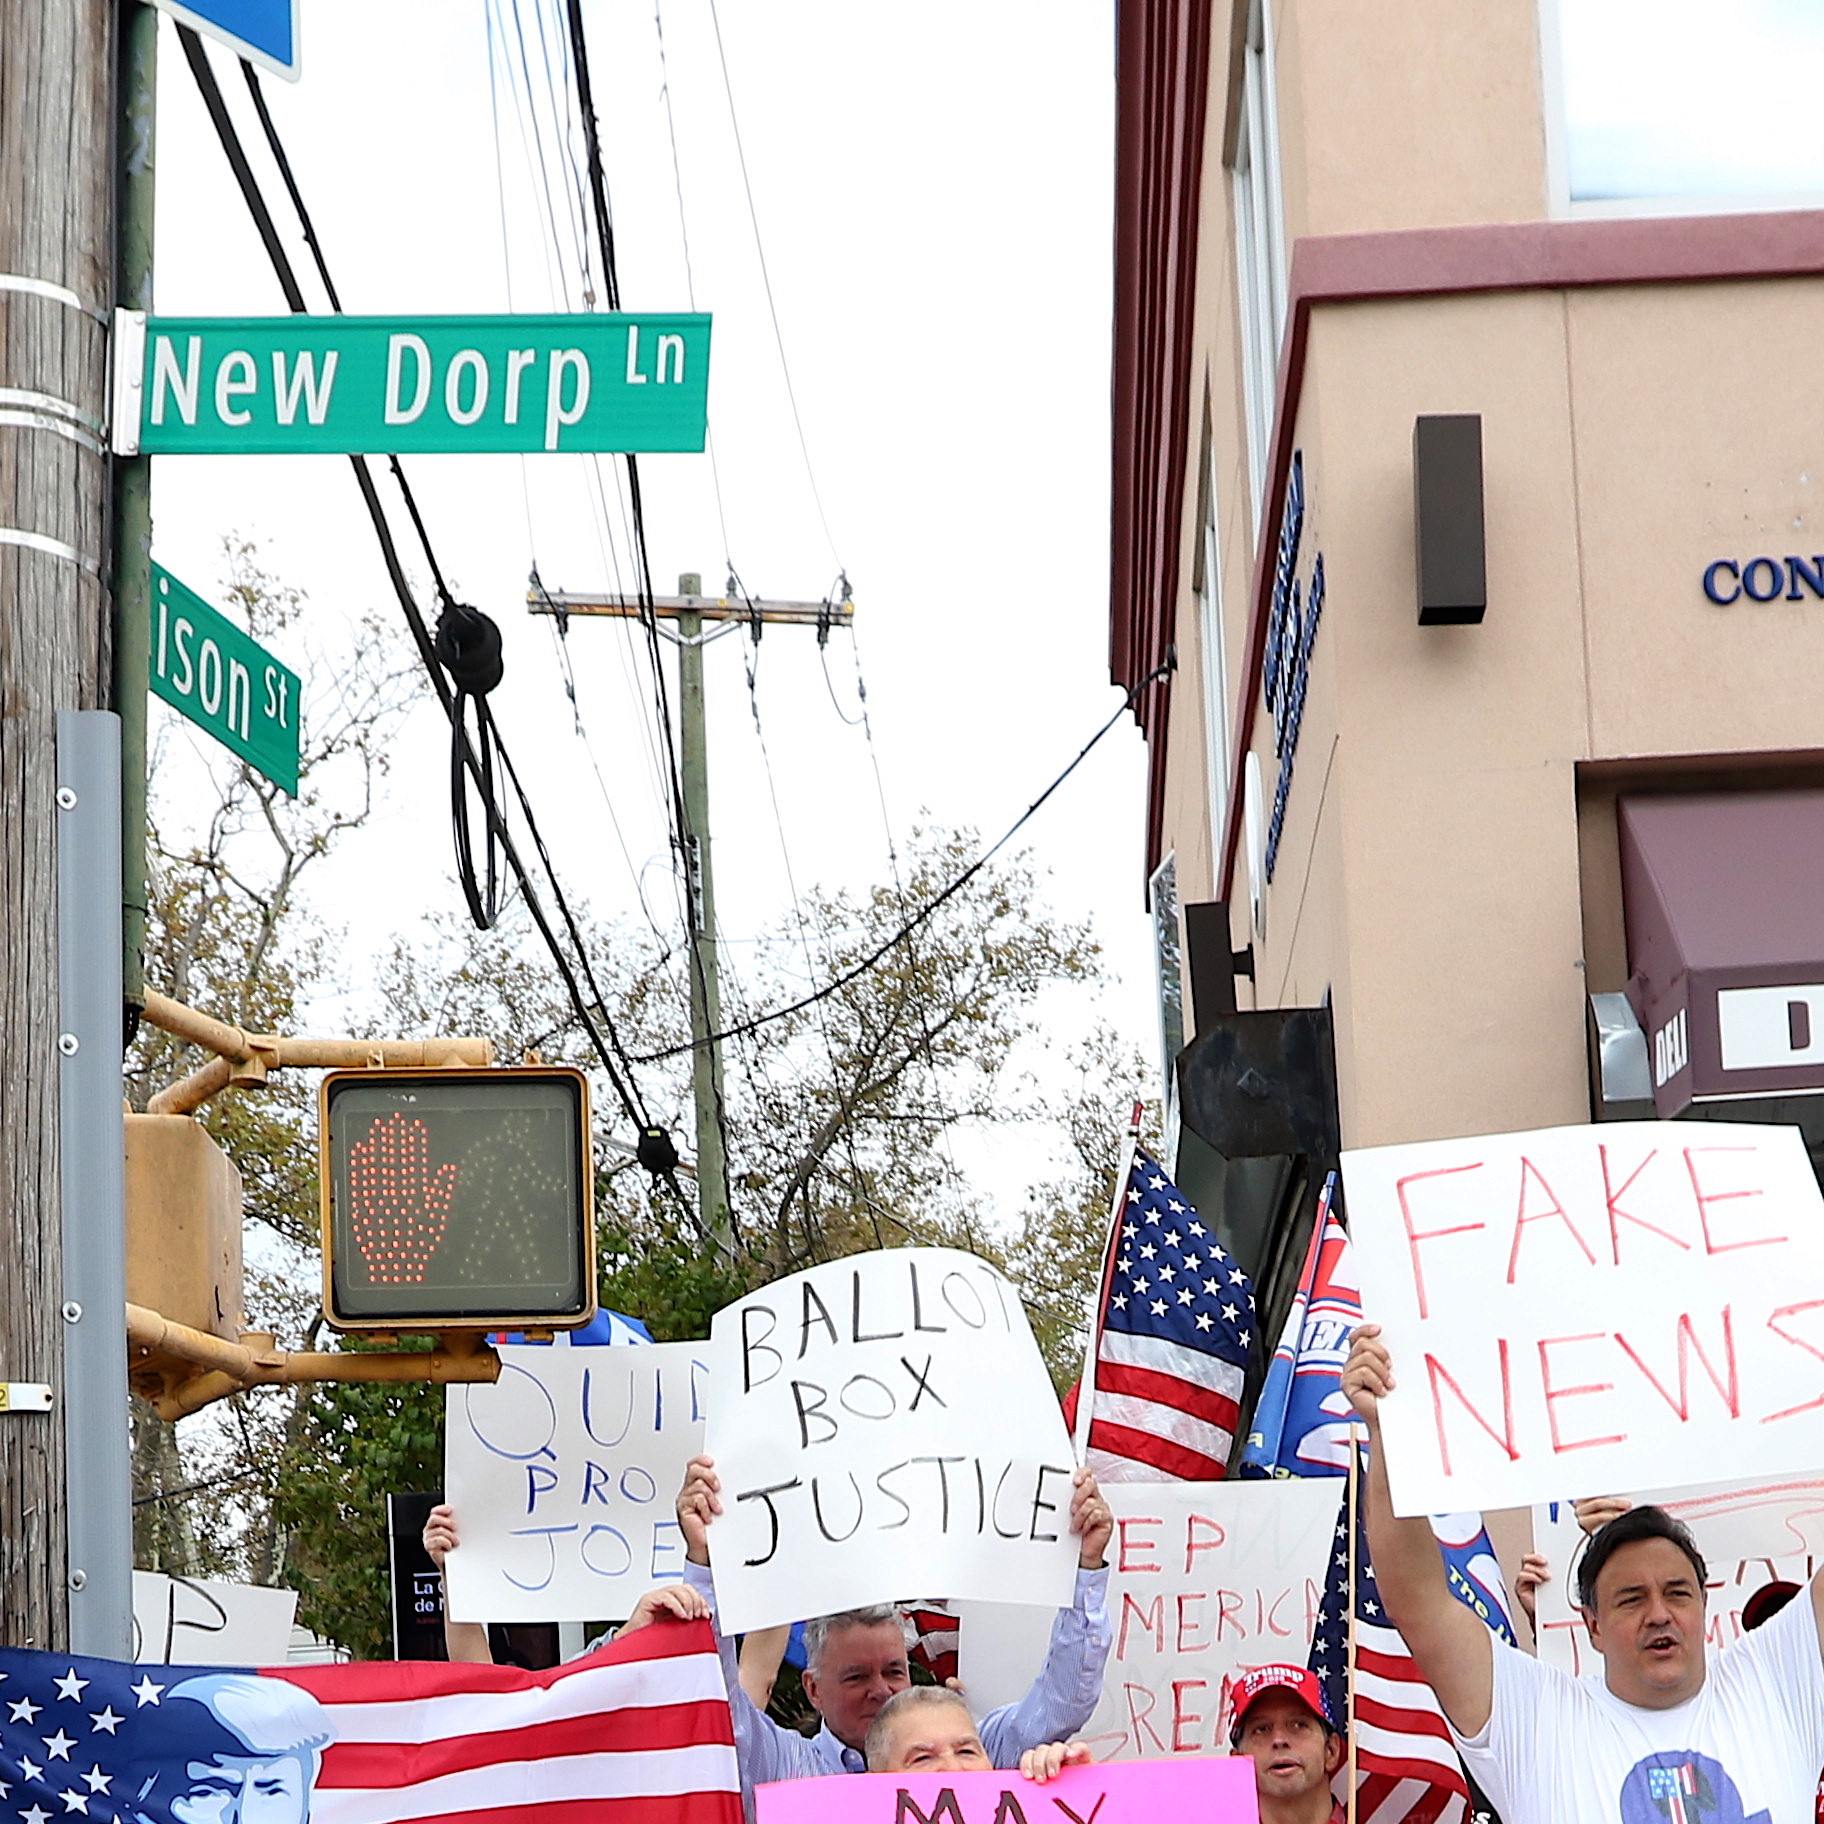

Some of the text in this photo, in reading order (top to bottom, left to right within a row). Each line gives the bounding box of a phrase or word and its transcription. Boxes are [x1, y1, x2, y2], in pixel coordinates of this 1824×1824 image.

[150, 324, 686, 452] New Dorp Ln
[263, 665, 290, 731] St
[1655, 1007, 1689, 1089] DELI
[1396, 1143, 1789, 1320] FAKE
[743, 1260, 1016, 1395] BALLOT
[790, 1354, 948, 1451] BOX
[526, 1461, 656, 1515] PRO
[735, 1454, 1073, 1568] JUSTICE
[413, 1580, 434, 1595] La
[502, 1520, 681, 1593] JOE
[414, 1598, 435, 1613] de
[1243, 1666, 1305, 1686] Trump
